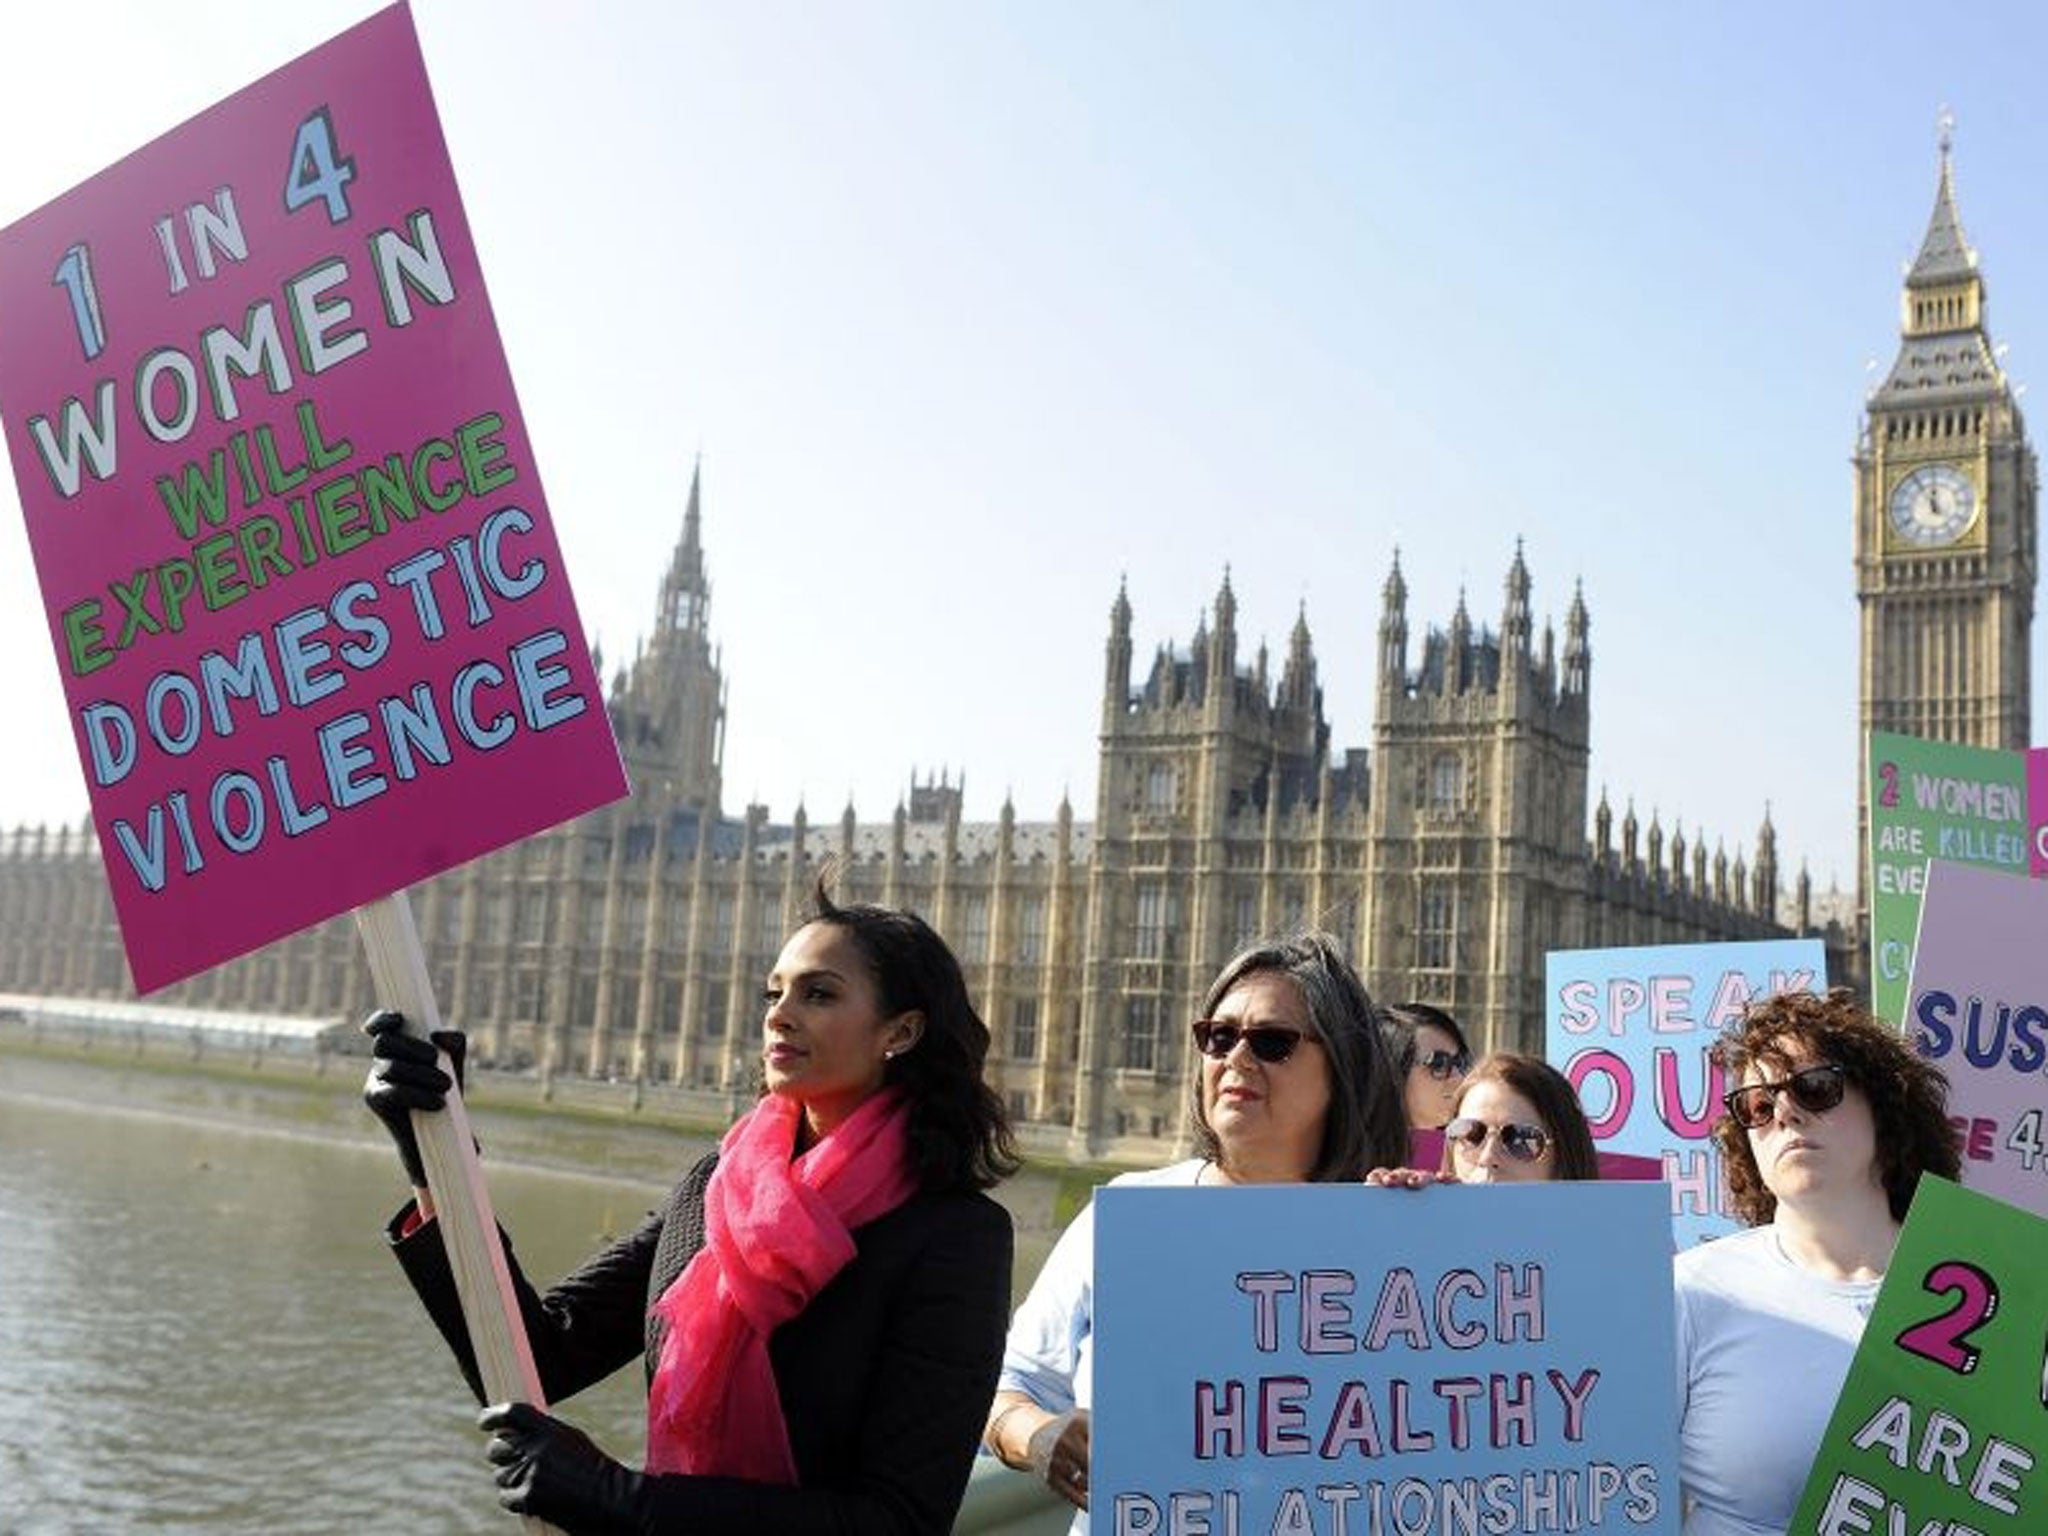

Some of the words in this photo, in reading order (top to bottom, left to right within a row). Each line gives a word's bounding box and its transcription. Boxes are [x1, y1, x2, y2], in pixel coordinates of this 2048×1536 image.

[52, 241, 107, 362] 1
[154, 184, 249, 295] IN
[281, 103, 358, 225] 4
[27, 207, 456, 498] WOMEN
[155, 400, 353, 538] WILL
[62, 411, 517, 676] EXPERIENCE
[82, 505, 548, 787] DOMESTIC
[113, 628, 588, 893] VIOLENCE
[1878, 761, 1900, 809] 2
[1912, 773, 2021, 822] WOMEN
[1879, 825, 1924, 854] ARE
[1939, 828, 2026, 864] KILLED
[1917, 989, 2048, 1075] SUS
[2006, 1110, 2048, 1175] 4
[1235, 1261, 1545, 1355] TEACH
[1894, 1260, 2000, 1375] 2
[1194, 1367, 1601, 1460] HEALTHY
[1850, 1396, 2036, 1516] ARE
[1114, 1461, 1660, 1536] RELATIONSHIPS
